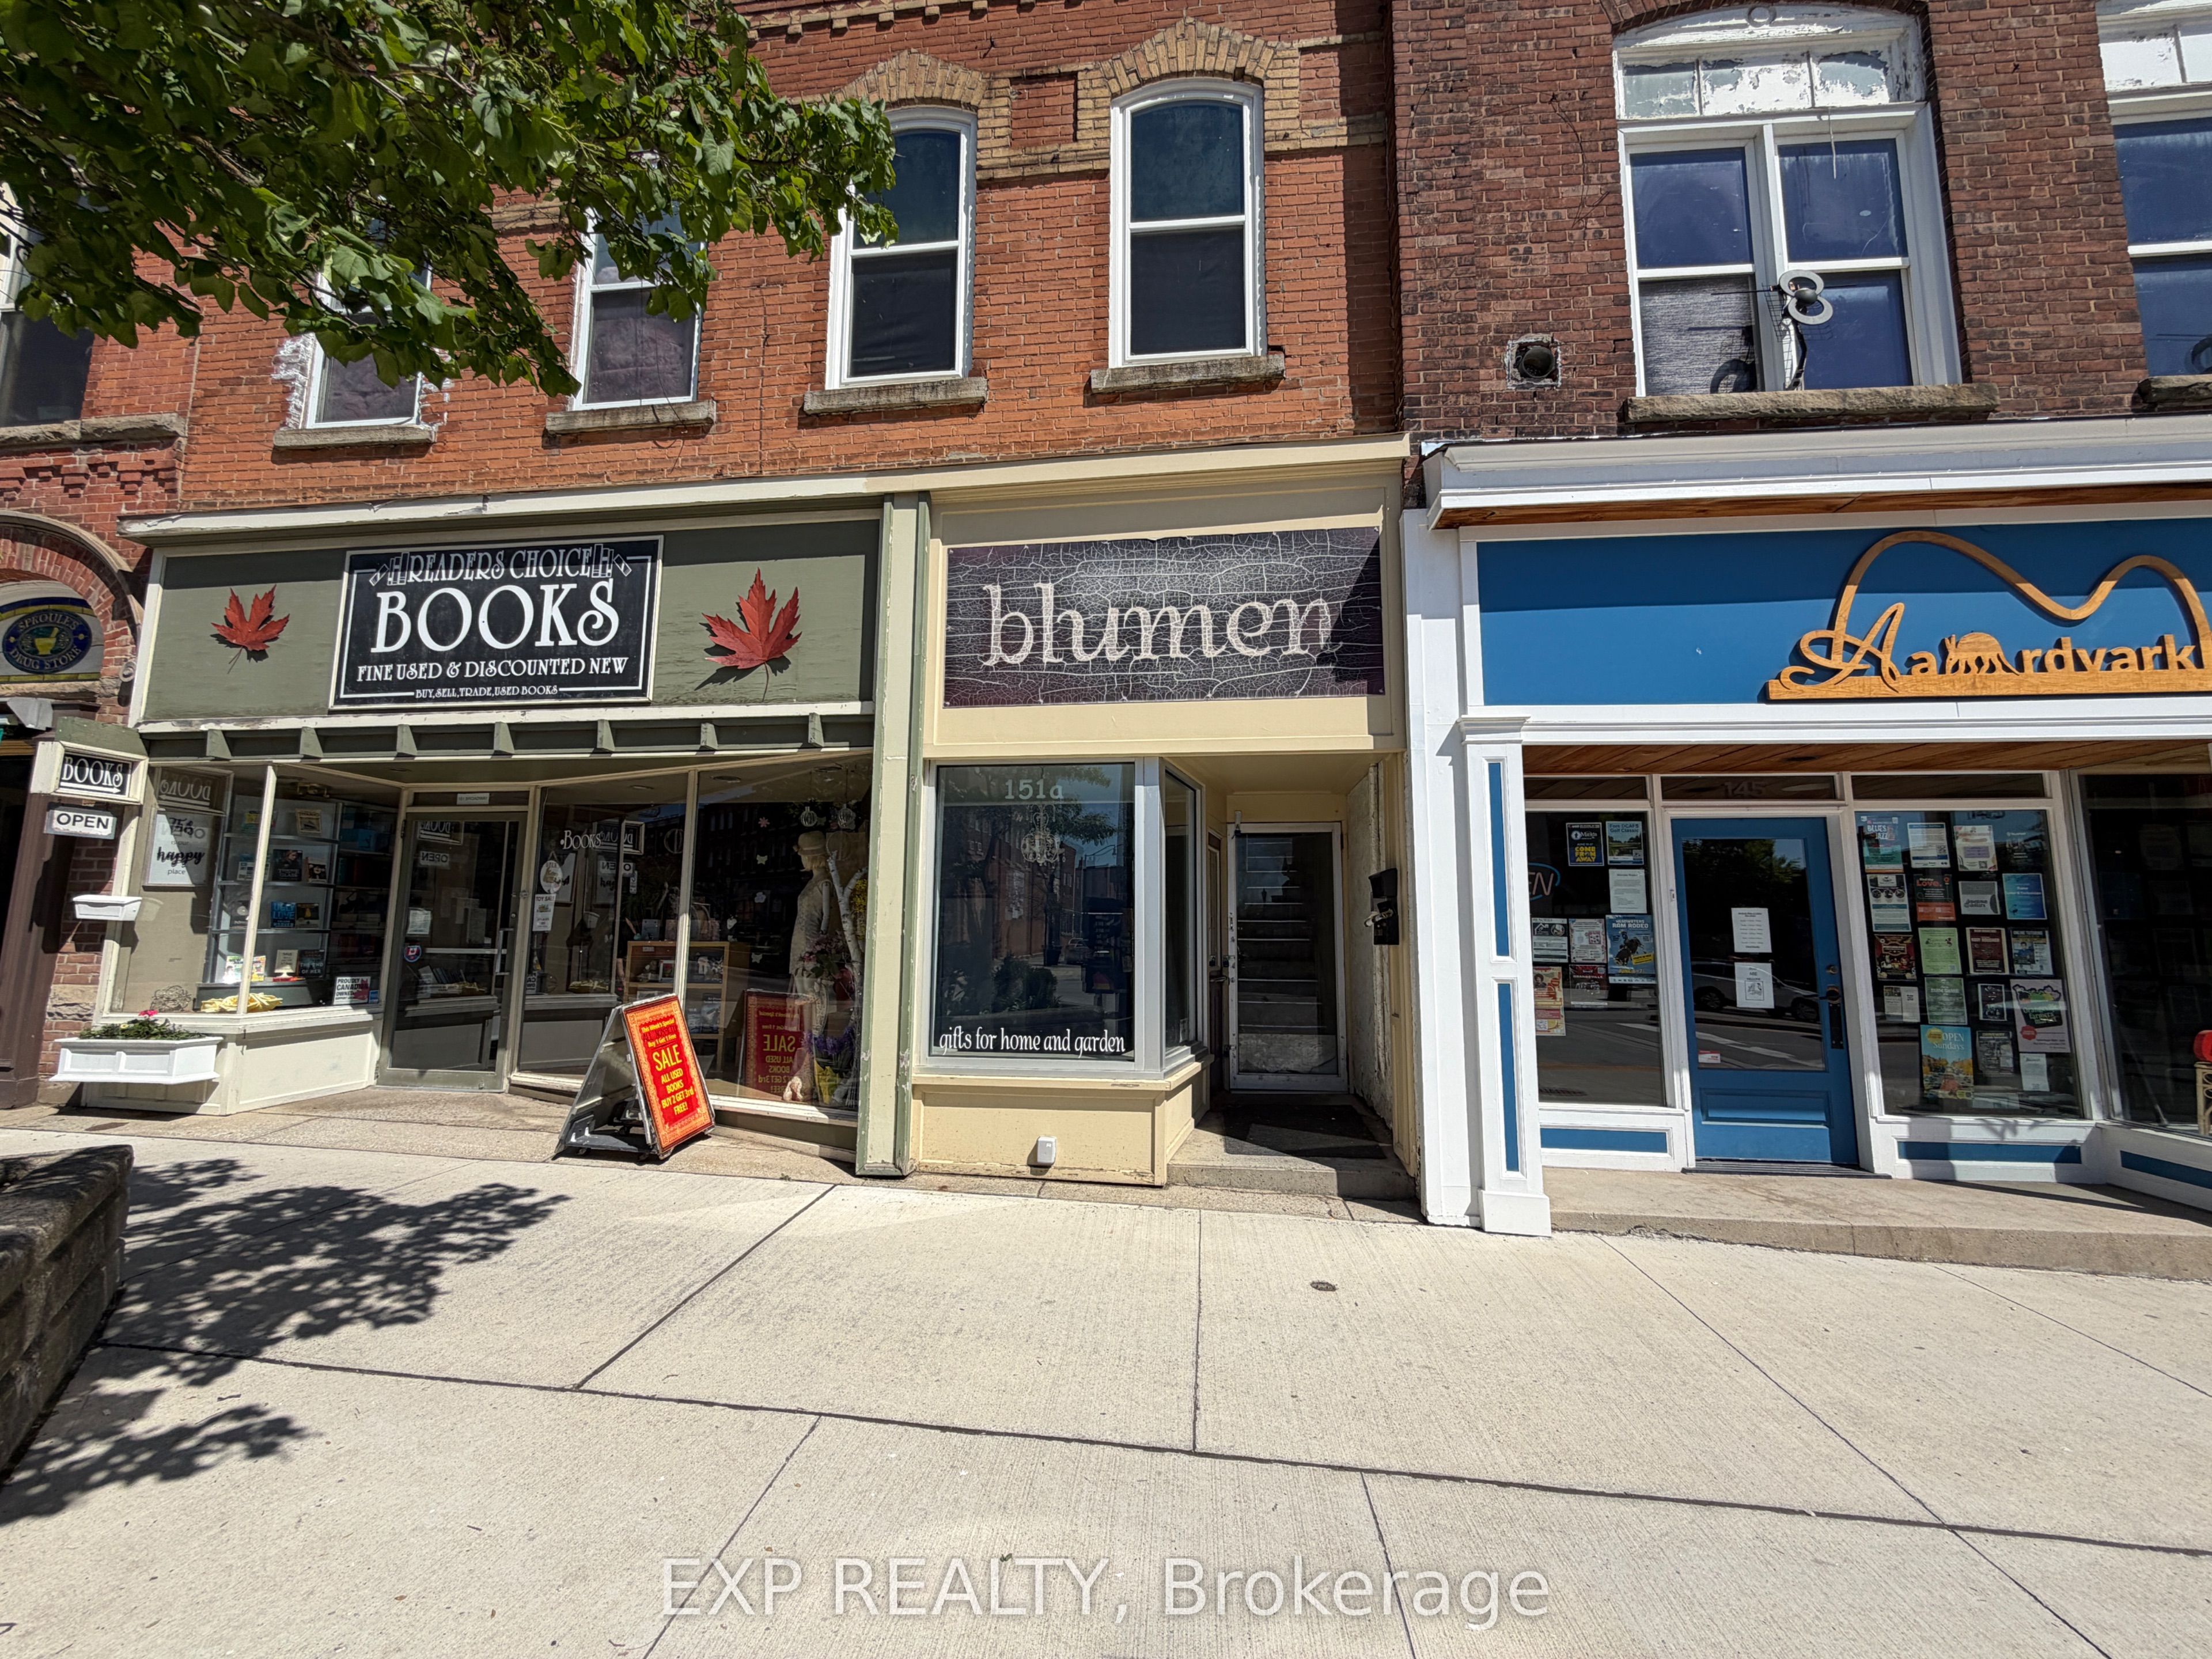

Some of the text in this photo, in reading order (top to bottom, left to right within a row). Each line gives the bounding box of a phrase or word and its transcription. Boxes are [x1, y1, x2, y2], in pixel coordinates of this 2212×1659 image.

[407, 547, 592, 583] READERS CHOICE
[18, 613, 79, 632] SPROULES
[370, 578, 619, 652] BOOKS
[980, 582, 1335, 666] blumen
[9, 646, 82, 670] DRUG STORE
[1779, 603, 2197, 692] Aardvark
[357, 657, 629, 682] FINE USED & DISCOUNTED NEW
[521, 685, 558, 695] BOOKS
[62, 756, 123, 788] BOOKS
[1005, 779, 1065, 800] 151a
[57, 813, 109, 830] OPEN
[157, 846, 205, 868] happy
[939, 1025, 1126, 1058] gifts for home and garden
[1933, 1041, 1964, 1051] Sundays
[1943, 1033, 1964, 1041] OPEN
[653, 1044, 682, 1071] SALE
[661, 1068, 684, 1084] ALL USED
[666, 1079, 684, 1094] BOOKS
[661, 1097, 671, 1109] BUY
[676, 1092, 685, 1103] GET
[685, 1086, 694, 1099] 3rd
[673, 1101, 688, 1115] FREE!
